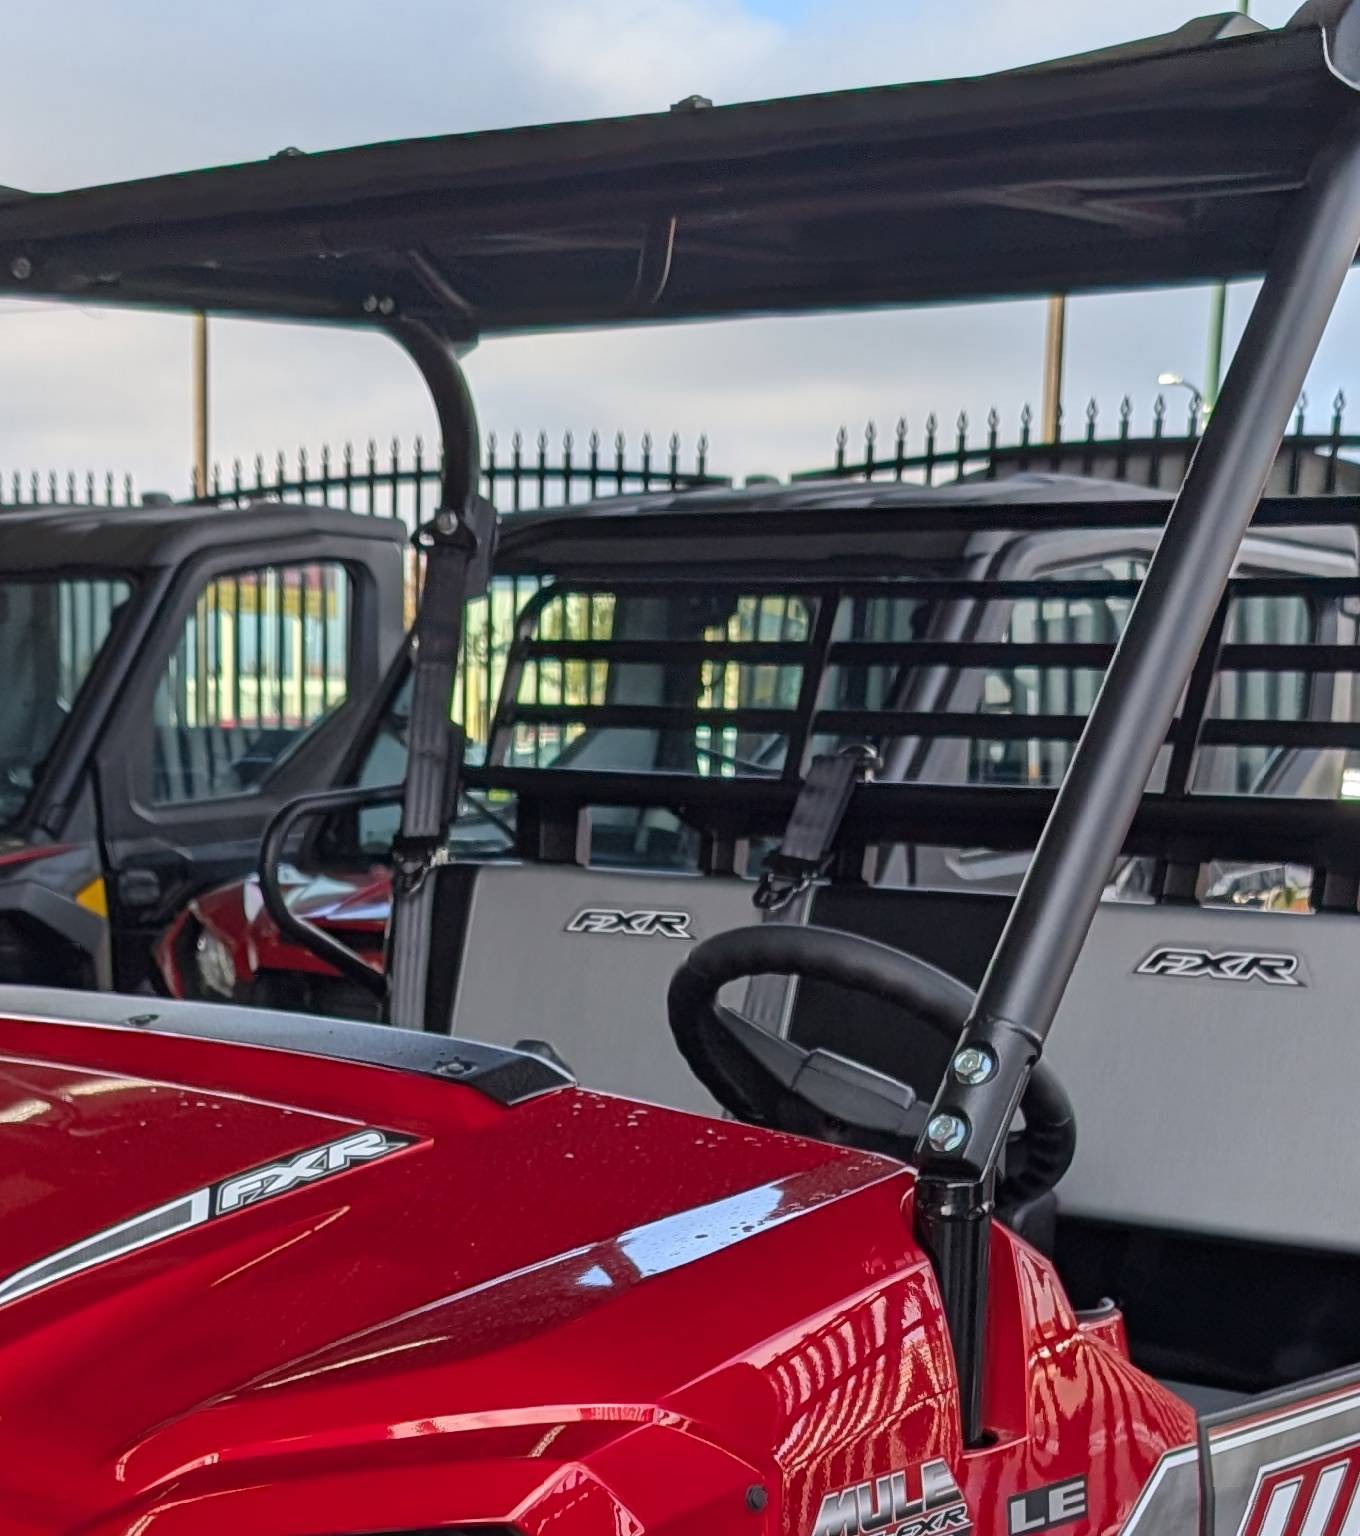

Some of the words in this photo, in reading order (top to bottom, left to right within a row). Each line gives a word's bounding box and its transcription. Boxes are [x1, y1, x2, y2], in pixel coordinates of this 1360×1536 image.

[565, 907, 695, 939] FXR
[1135, 946, 1306, 987] FXR
[218, 1130, 398, 1213] FXR
[1009, 1480, 1086, 1536] LE
